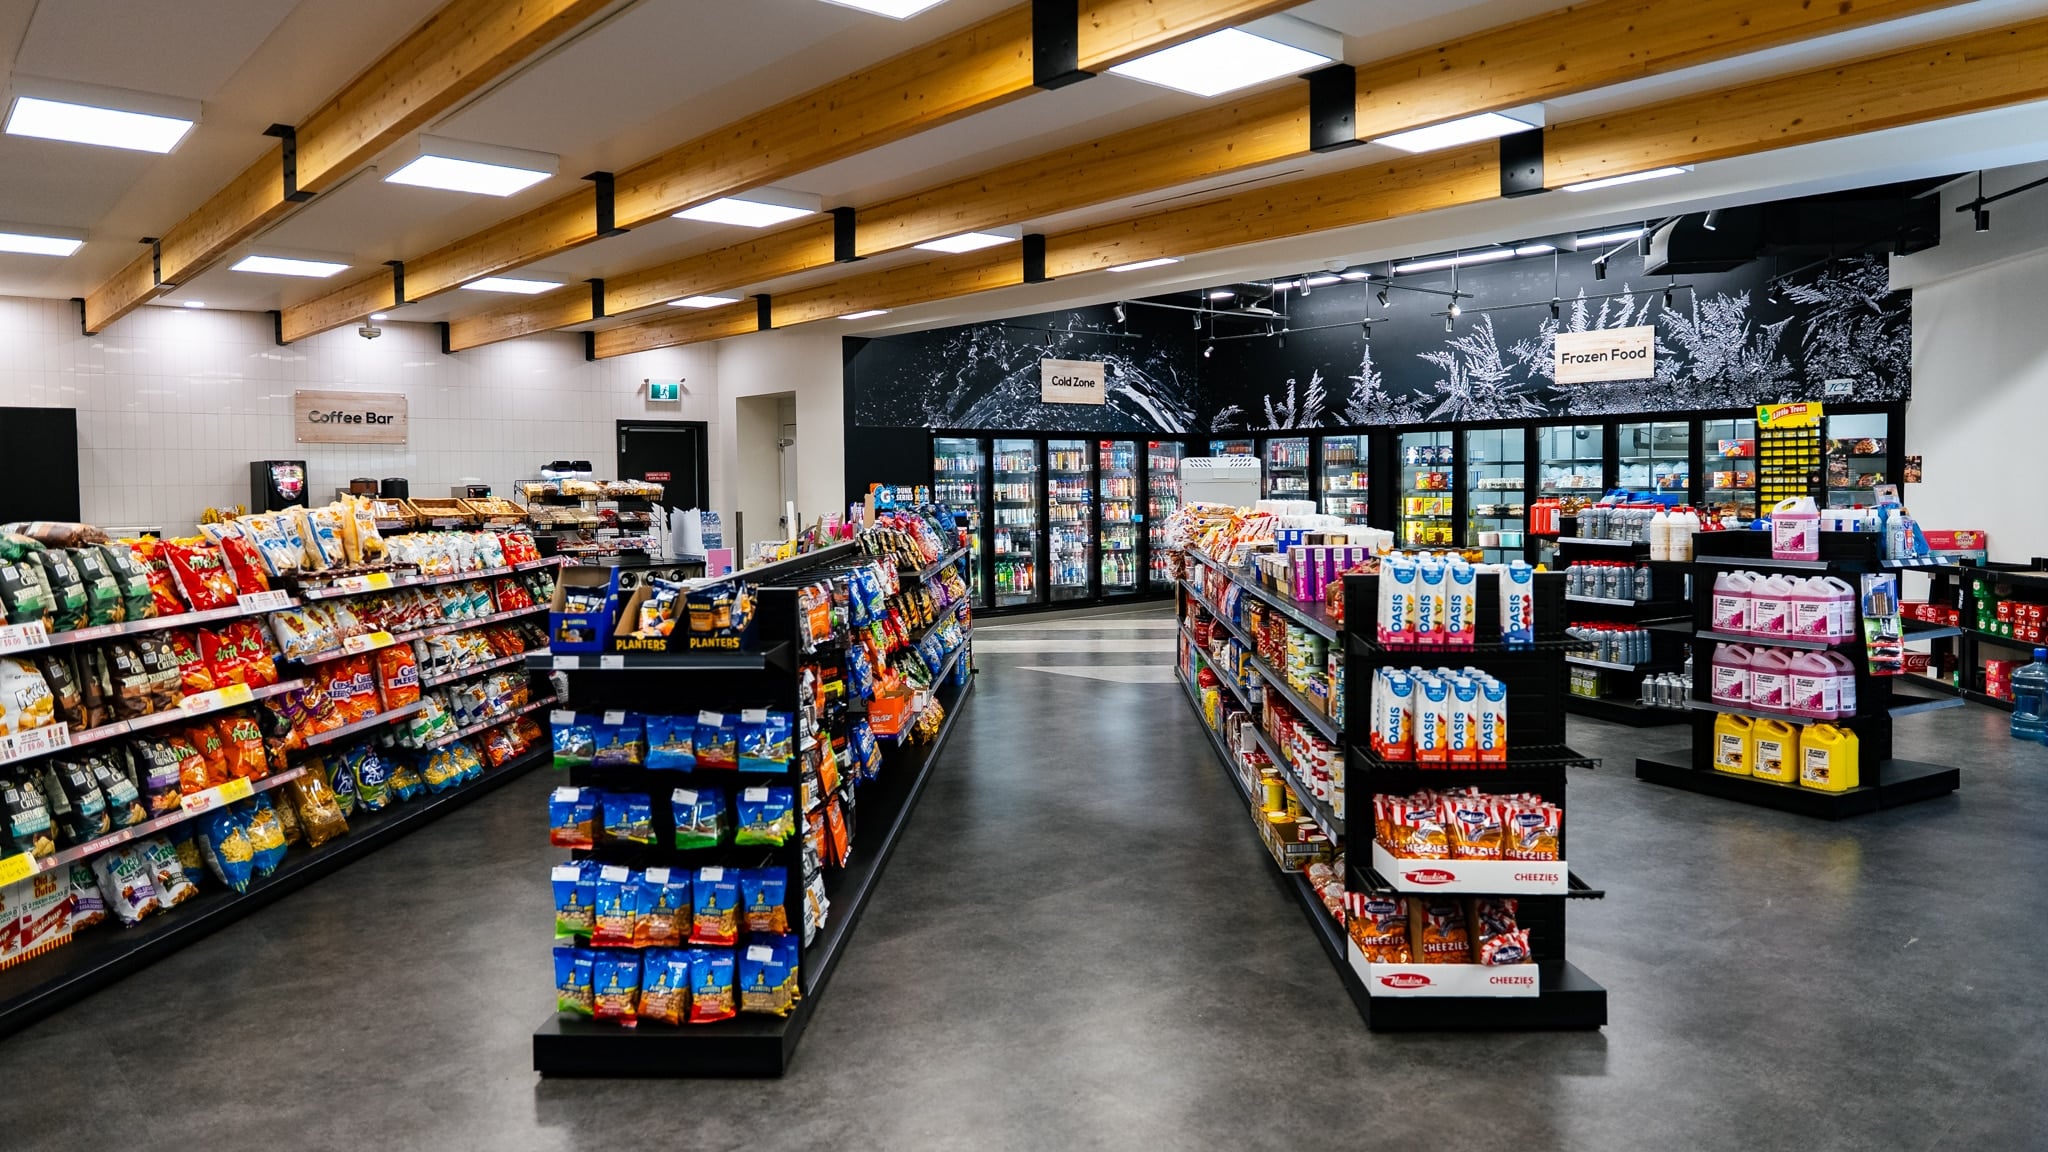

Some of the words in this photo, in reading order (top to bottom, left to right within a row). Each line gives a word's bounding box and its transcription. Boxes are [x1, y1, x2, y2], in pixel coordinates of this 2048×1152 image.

[1561, 352, 1608, 365] Frozen
[1611, 346, 1647, 361] Food
[1051, 375, 1072, 387] Cold
[1073, 376, 1096, 388] Zone
[1827, 382, 1851, 393] ICE
[308, 410, 362, 424] Coffee
[365, 411, 394, 425] Bar
[1772, 407, 1789, 420] Little
[1789, 405, 1807, 415] Trees
[1391, 594, 1403, 633] OASIS
[1419, 594, 1431, 633] OASIS
[1449, 594, 1462, 633] OASIS
[1510, 594, 1520, 632] OASIS
[616, 639, 667, 651] PLANTERS
[690, 637, 741, 649] PLANTERS
[1389, 707, 1400, 744] OASIS
[1423, 712, 1434, 751] OASIS
[1453, 712, 1464, 751] OASIS
[1482, 712, 1493, 751] OASIS
[1505, 848, 1553, 861] CHEEZIES
[33, 874, 48, 888] Old
[1413, 870, 1448, 883] Hawkins
[1514, 872, 1559, 882] CHEEZIES
[34, 882, 57, 899] Dutch
[31, 908, 62, 938] Ketchup
[1424, 941, 1470, 953] CHEEZIES
[1388, 975, 1424, 986] Hawkins
[1489, 976, 1534, 985] CHEEZIES
